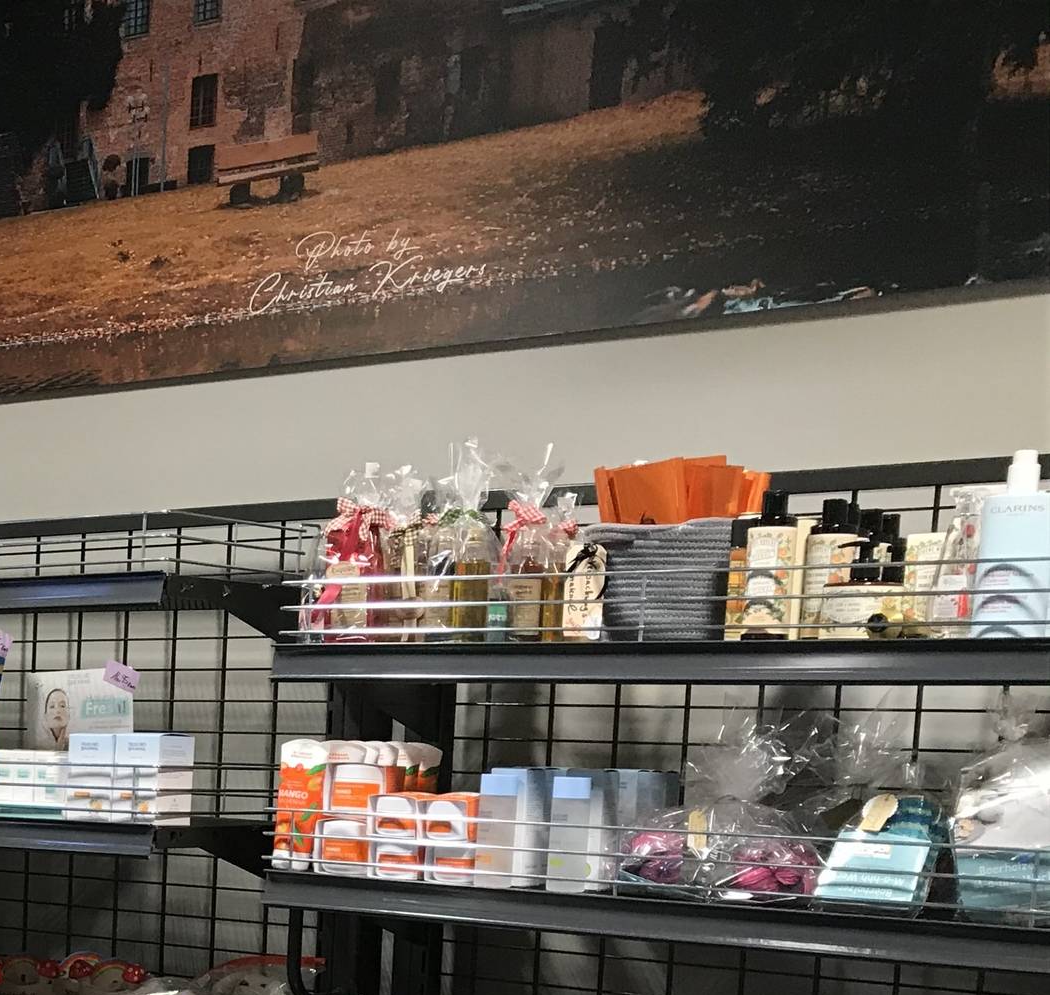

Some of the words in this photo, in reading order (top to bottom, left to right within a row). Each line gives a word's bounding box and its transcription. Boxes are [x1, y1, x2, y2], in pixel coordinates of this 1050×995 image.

[296, 230, 374, 271] Photo
[386, 228, 421, 260] by
[249, 272, 357, 316] Christian
[370, 256, 487, 298] Kriegers
[990, 503, 1046, 514] CLARINS
